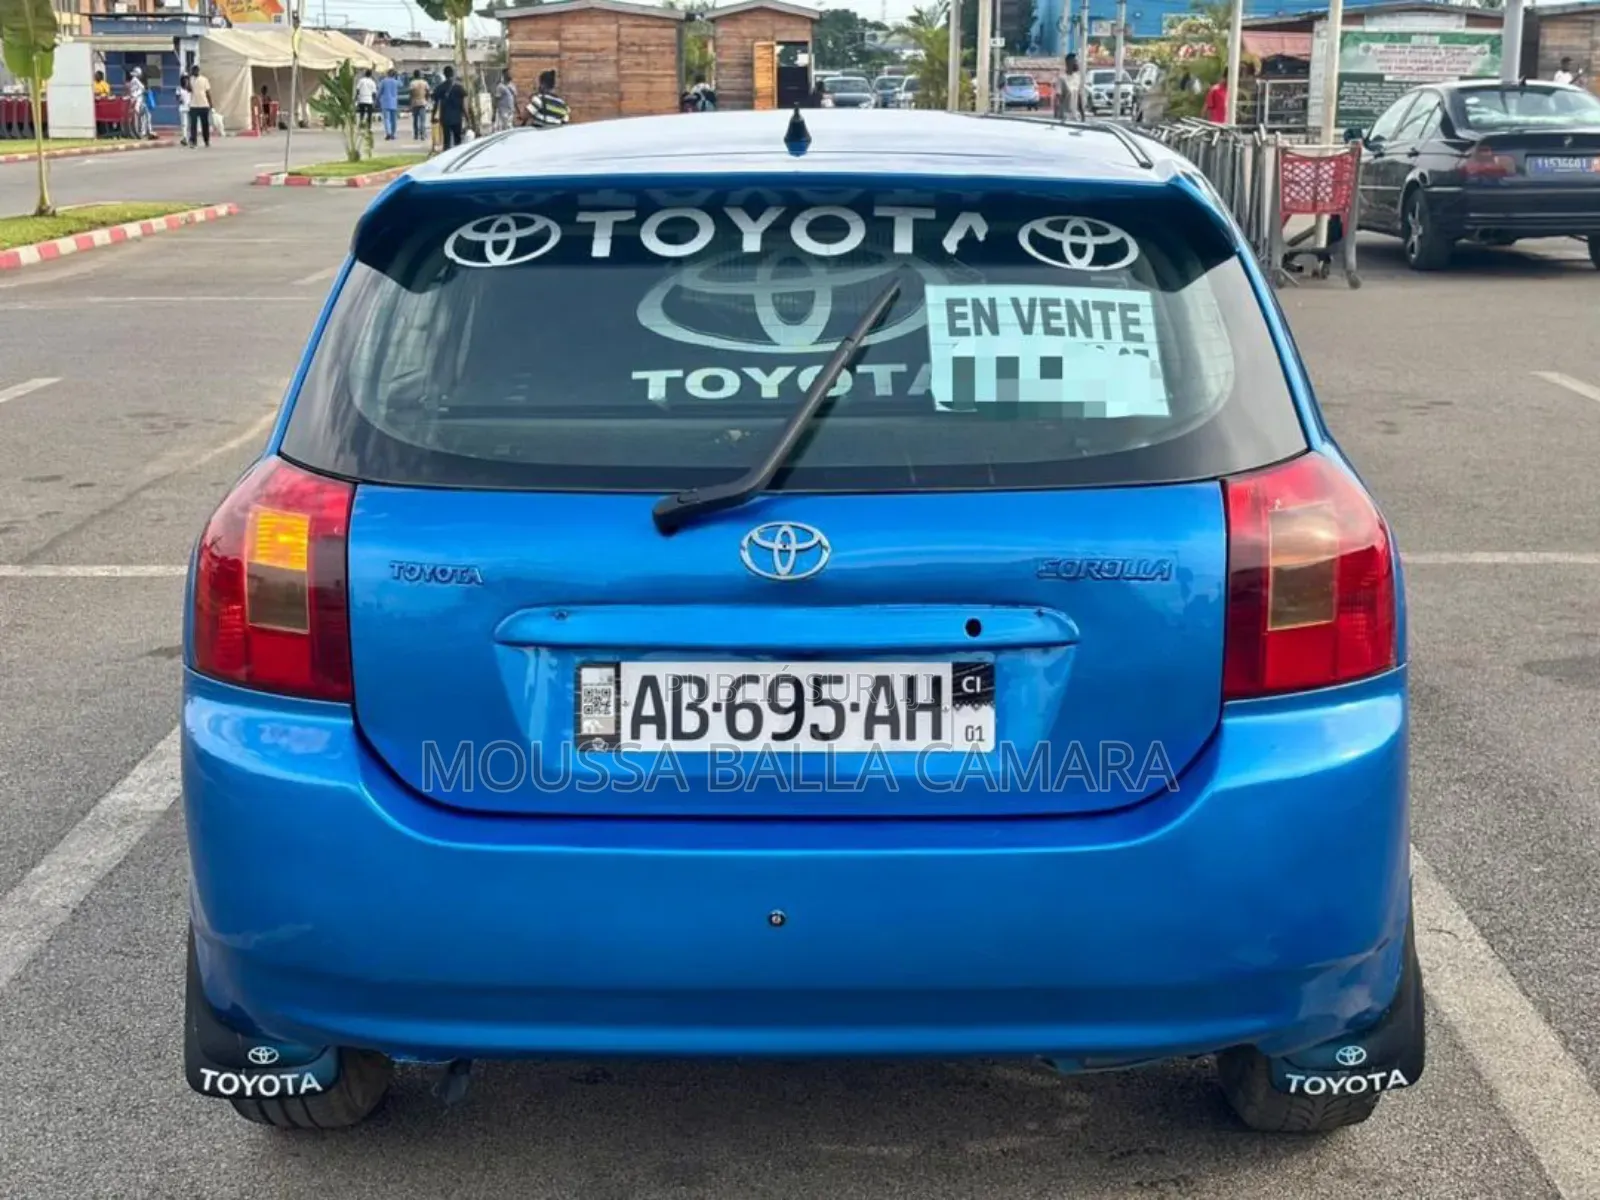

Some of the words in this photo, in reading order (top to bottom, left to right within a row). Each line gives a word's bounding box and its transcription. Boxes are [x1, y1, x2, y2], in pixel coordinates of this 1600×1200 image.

[576, 205, 989, 257] TOYOTA
[945, 297, 1000, 337] EN
[1010, 297, 1145, 342] VENTE
[388, 561, 484, 586] TOYOTA
[1037, 556, 1173, 582] COROLLA
[961, 675, 982, 693] CI
[964, 724, 985, 742] 01
[200, 1067, 323, 1097] TOYOTA
[1285, 1068, 1409, 1096] TOYOTA
